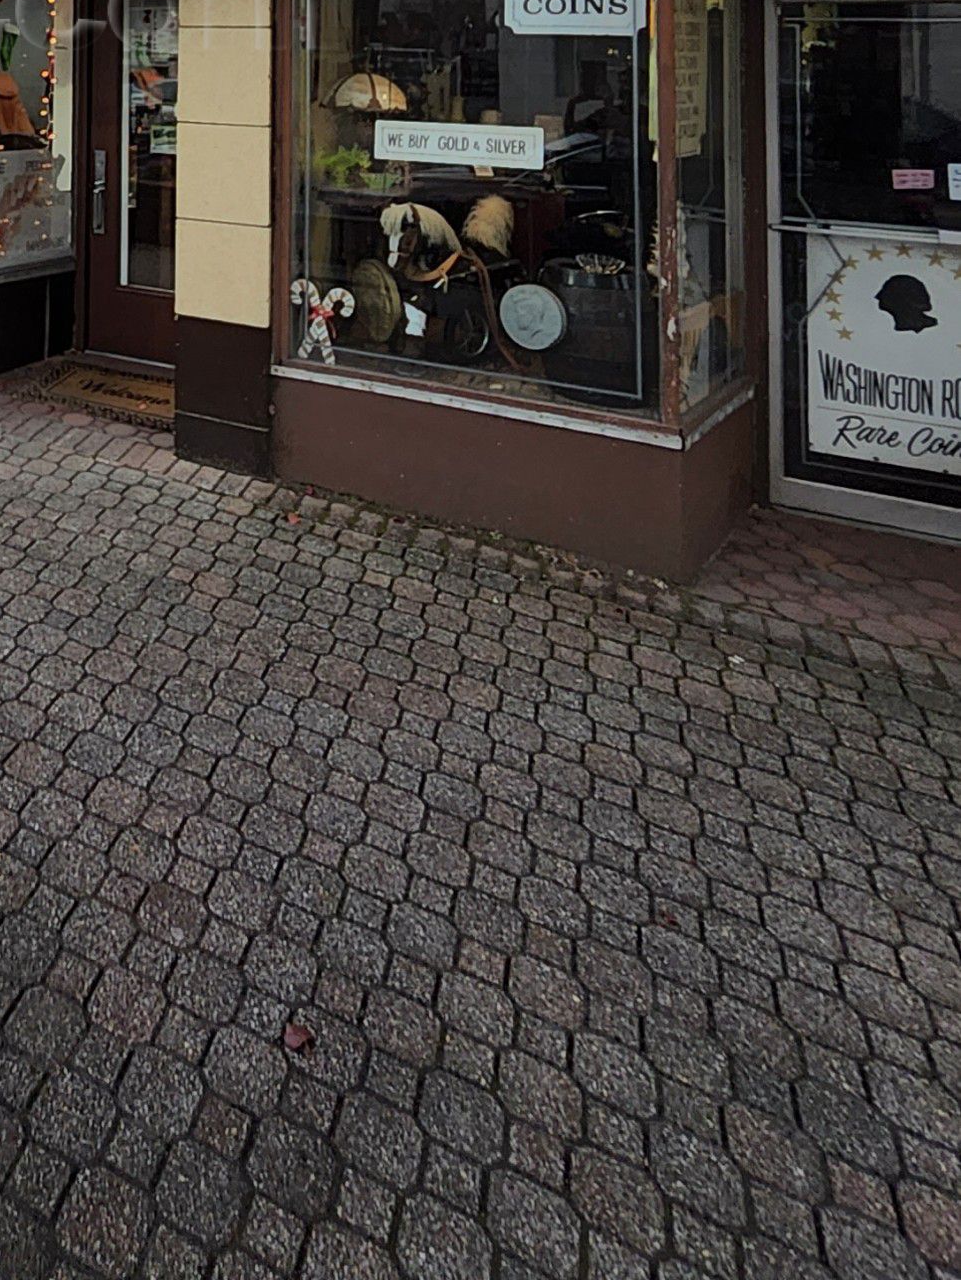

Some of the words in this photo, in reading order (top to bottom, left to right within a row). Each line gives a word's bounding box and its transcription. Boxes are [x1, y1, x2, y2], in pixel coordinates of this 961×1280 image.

[388, 133, 404, 148] WE
[408, 134, 430, 149] BUY
[437, 135, 470, 152] GOLD
[485, 138, 527, 155] SILVER
[78, 379, 171, 406] Welcome
[817, 349, 934, 417] WASHINGTON
[832, 415, 901, 449] Rare
